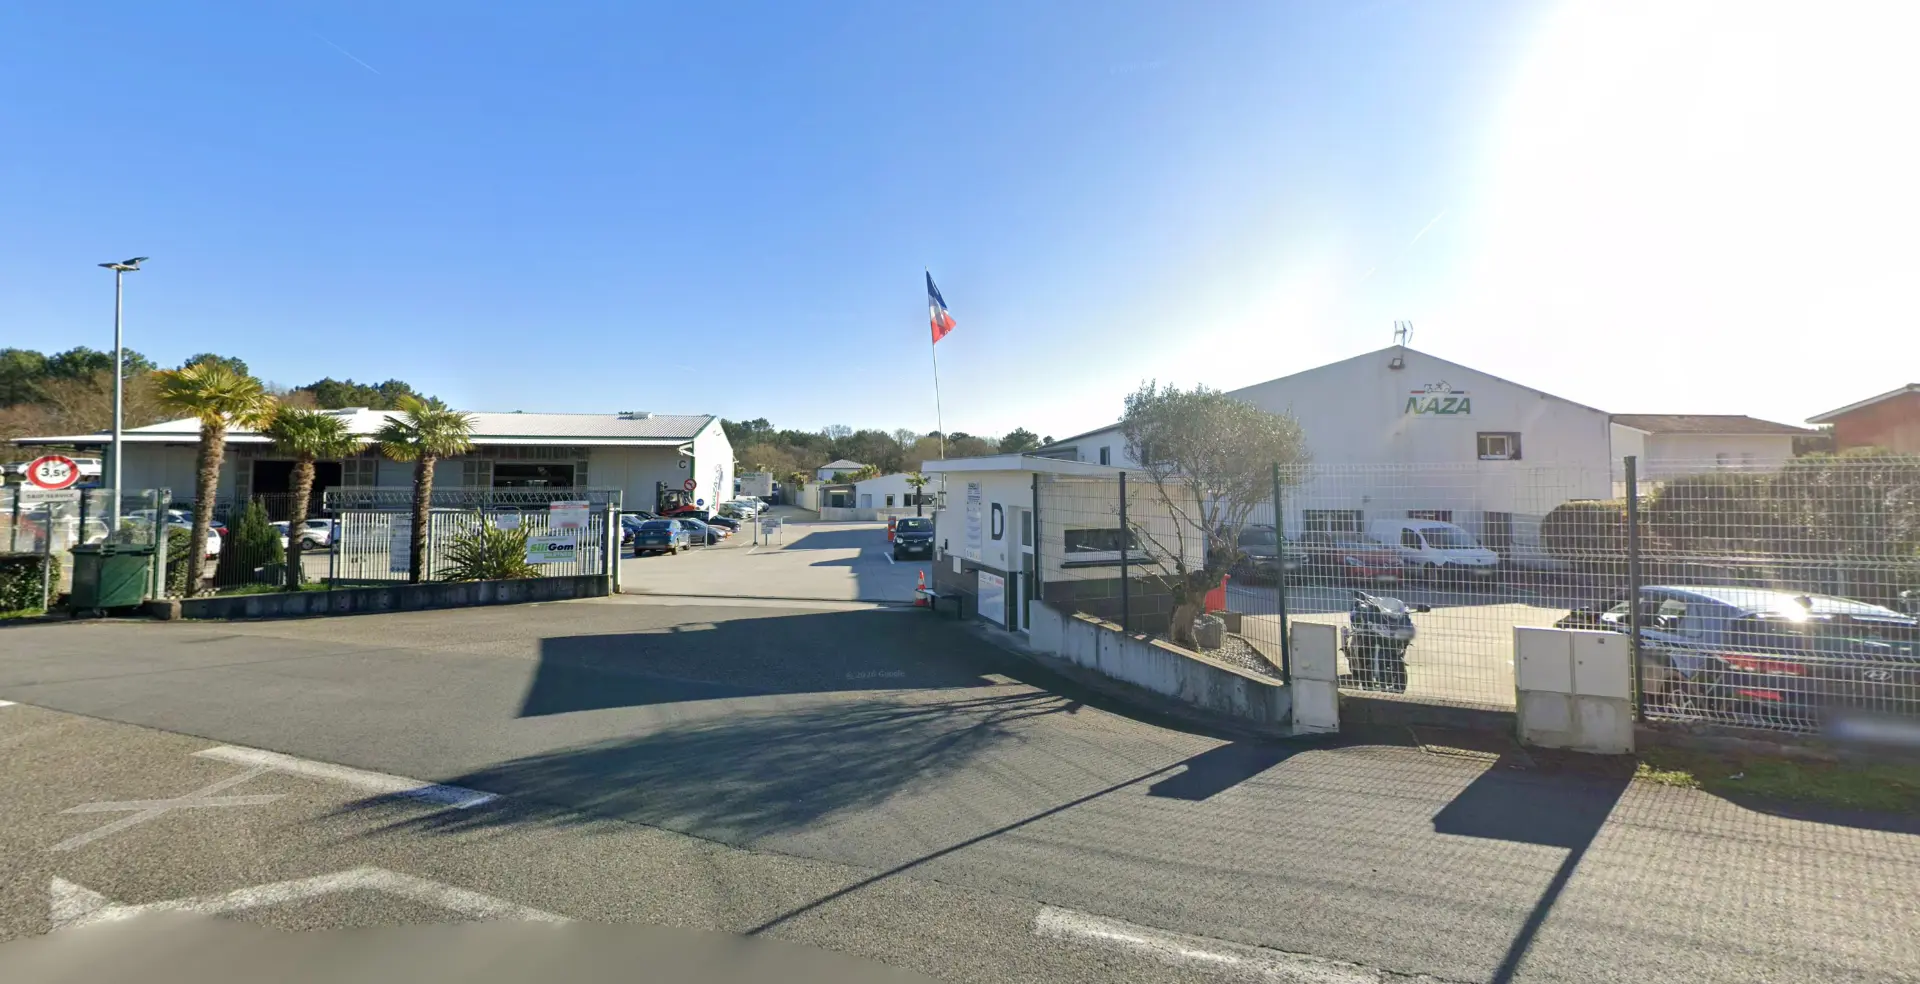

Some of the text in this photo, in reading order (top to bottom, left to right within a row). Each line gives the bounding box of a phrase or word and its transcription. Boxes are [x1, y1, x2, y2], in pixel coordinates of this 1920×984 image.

[1405, 397, 1470, 414] NAZA
[679, 461, 686, 469] C
[991, 502, 1004, 541] D
